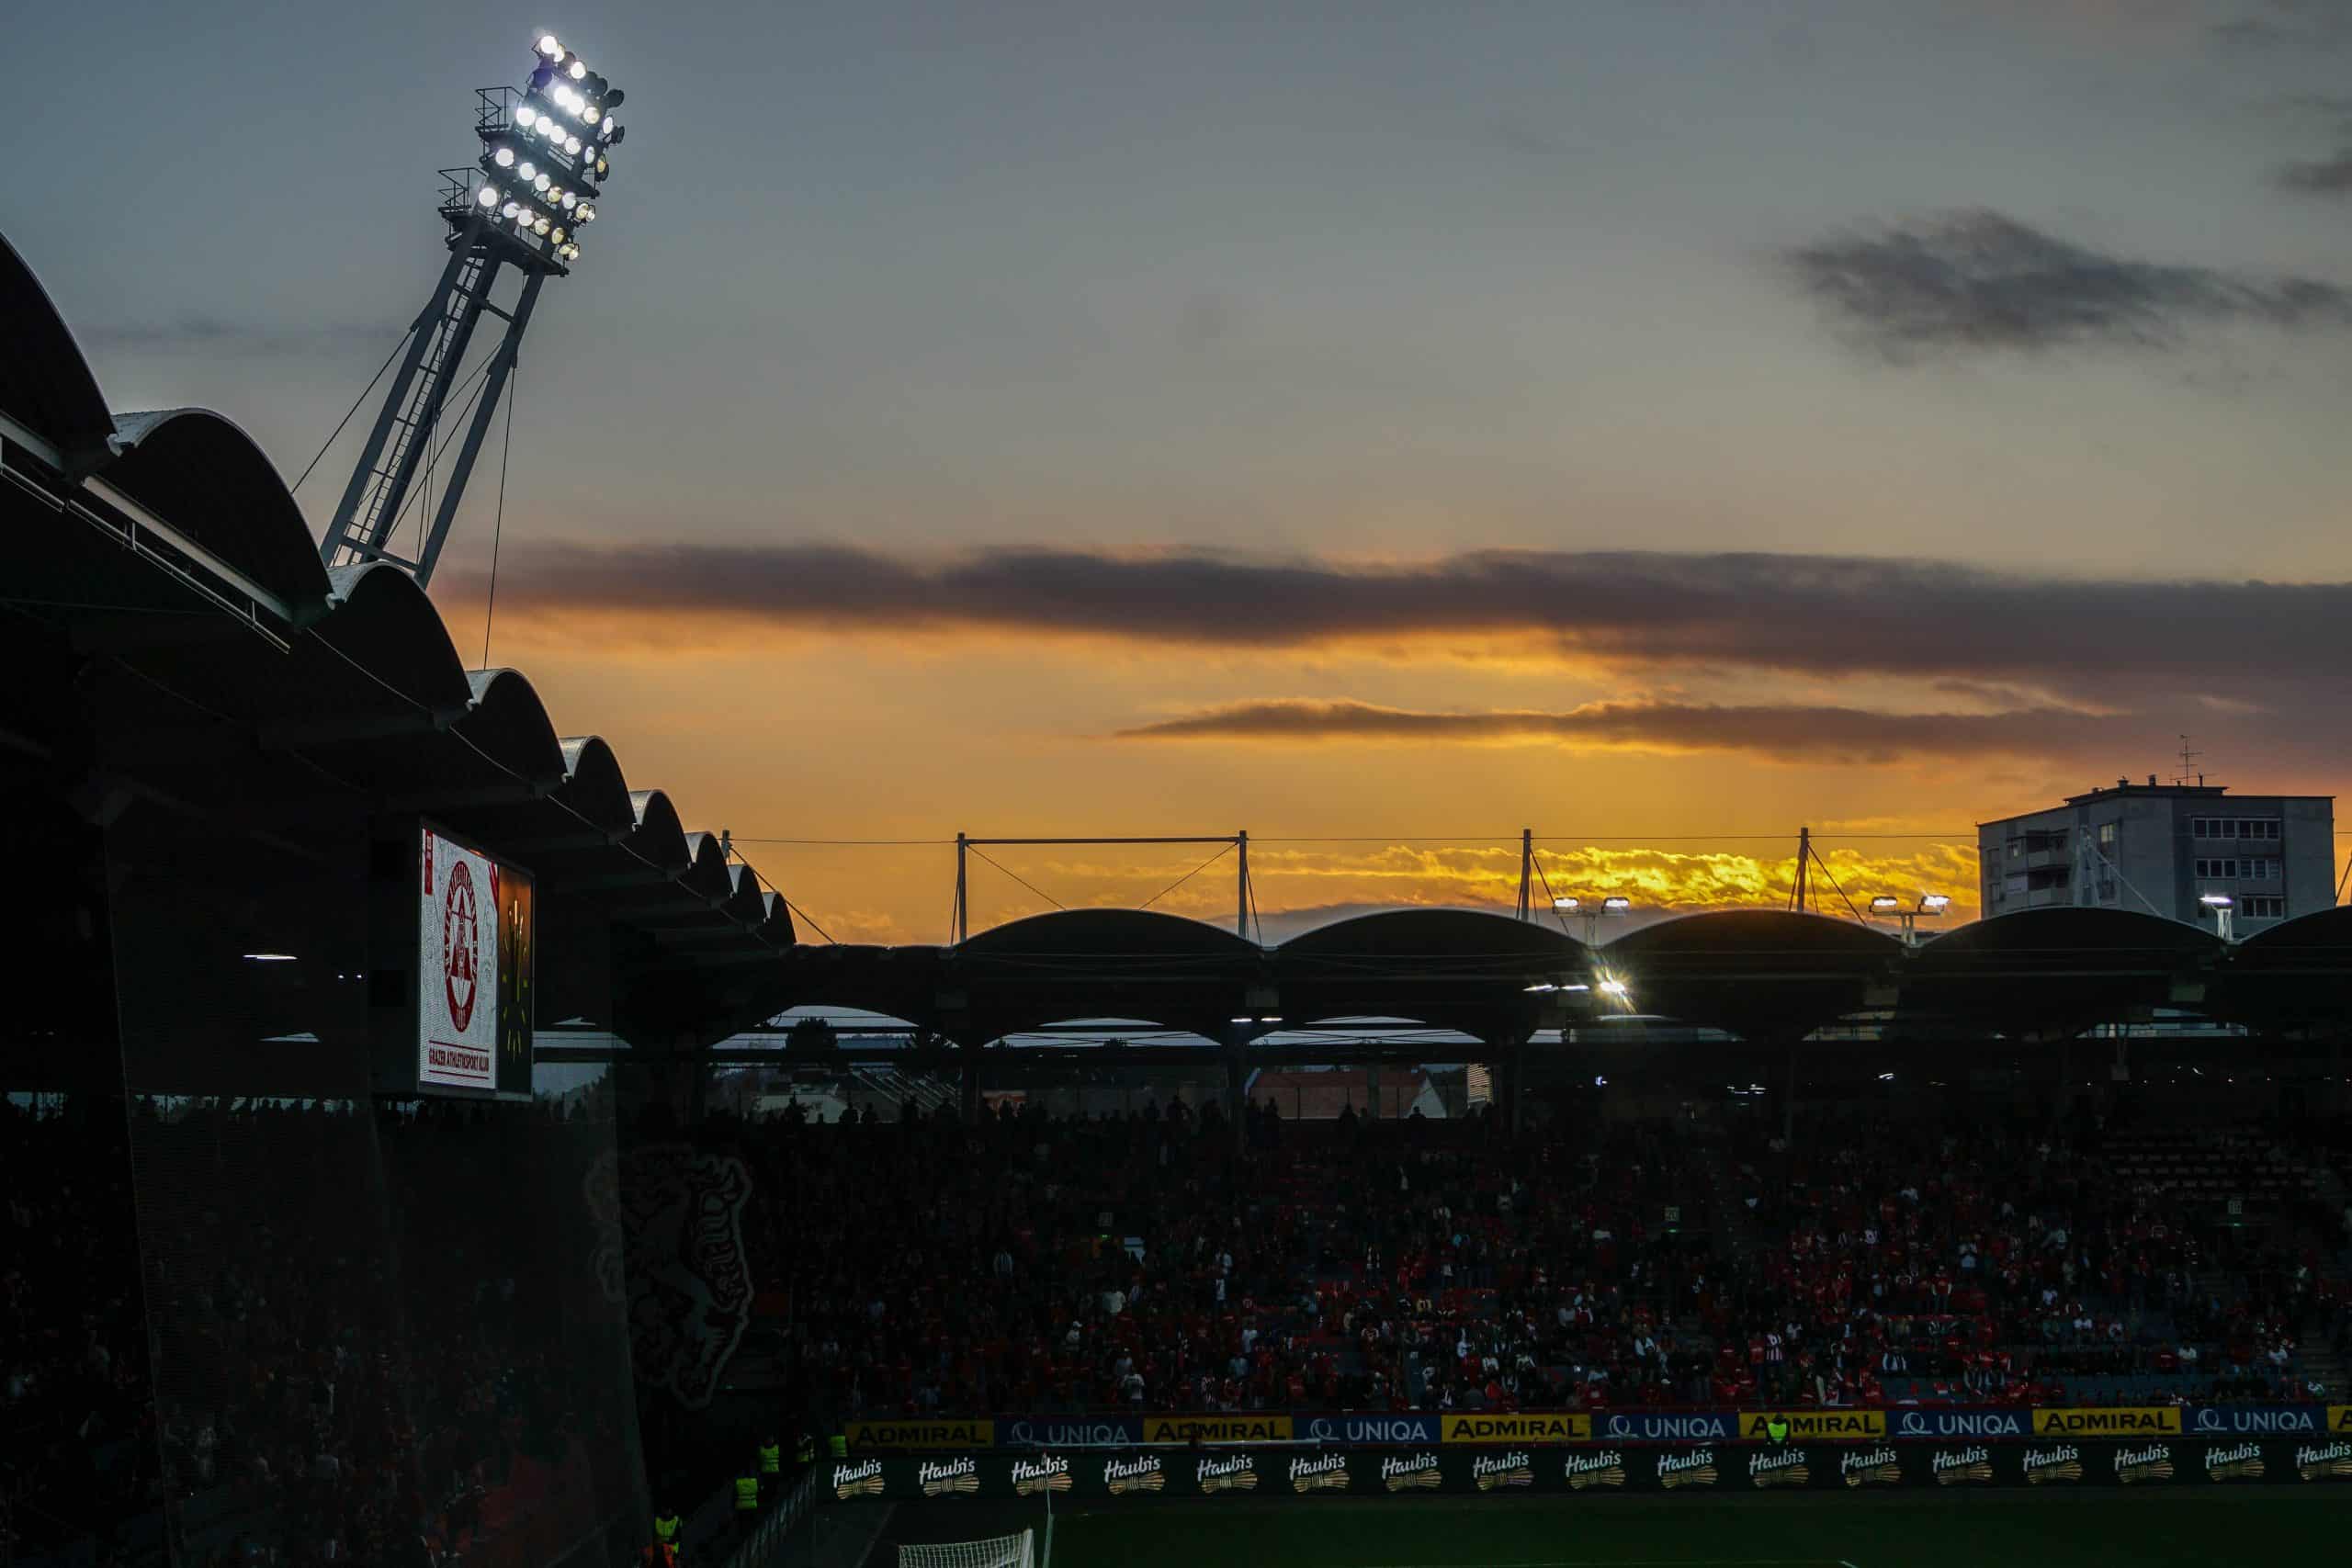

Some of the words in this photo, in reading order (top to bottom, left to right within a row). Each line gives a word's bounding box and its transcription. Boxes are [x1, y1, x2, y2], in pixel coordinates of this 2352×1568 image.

[1047, 1424, 1129, 1445] UNIQA
[1155, 1421, 1287, 1441] ADMIRAL
[1346, 1421, 1429, 1441] UNIQA
[1452, 1418, 1584, 1438] ADMIRAL
[1645, 1417, 1726, 1438] UNIQA
[1749, 1416, 1881, 1435] AMIRAL
[1939, 1414, 2020, 1435] UNIQA
[2044, 1413, 2174, 1432] ADMIRAL
[2233, 1412, 2314, 1432] UNIQA
[855, 1425, 986, 1445] ADMIRAL
[1196, 1454, 1254, 1481] Haubis
[1288, 1453, 1346, 1480] Haubis
[1381, 1452, 1439, 1479] Haubis
[1472, 1452, 1530, 1478] Haubis
[1566, 1450, 1623, 1477] Haubis
[1657, 1450, 1713, 1476] Haubis
[1748, 1449, 1806, 1474] Haubis
[1840, 1449, 1897, 1473] Haubis
[1932, 1448, 1990, 1472] Haubis
[2022, 1446, 2080, 1471] Haubis
[2113, 1445, 2170, 1470] Haubis
[2205, 1444, 2262, 1470] Haubis
[2296, 1442, 2352, 1468] Haubis
[832, 1460, 882, 1488] Haubis
[919, 1457, 976, 1484] Haubis
[1011, 1457, 1069, 1483] Haubis
[1103, 1456, 1162, 1483] Haubis
